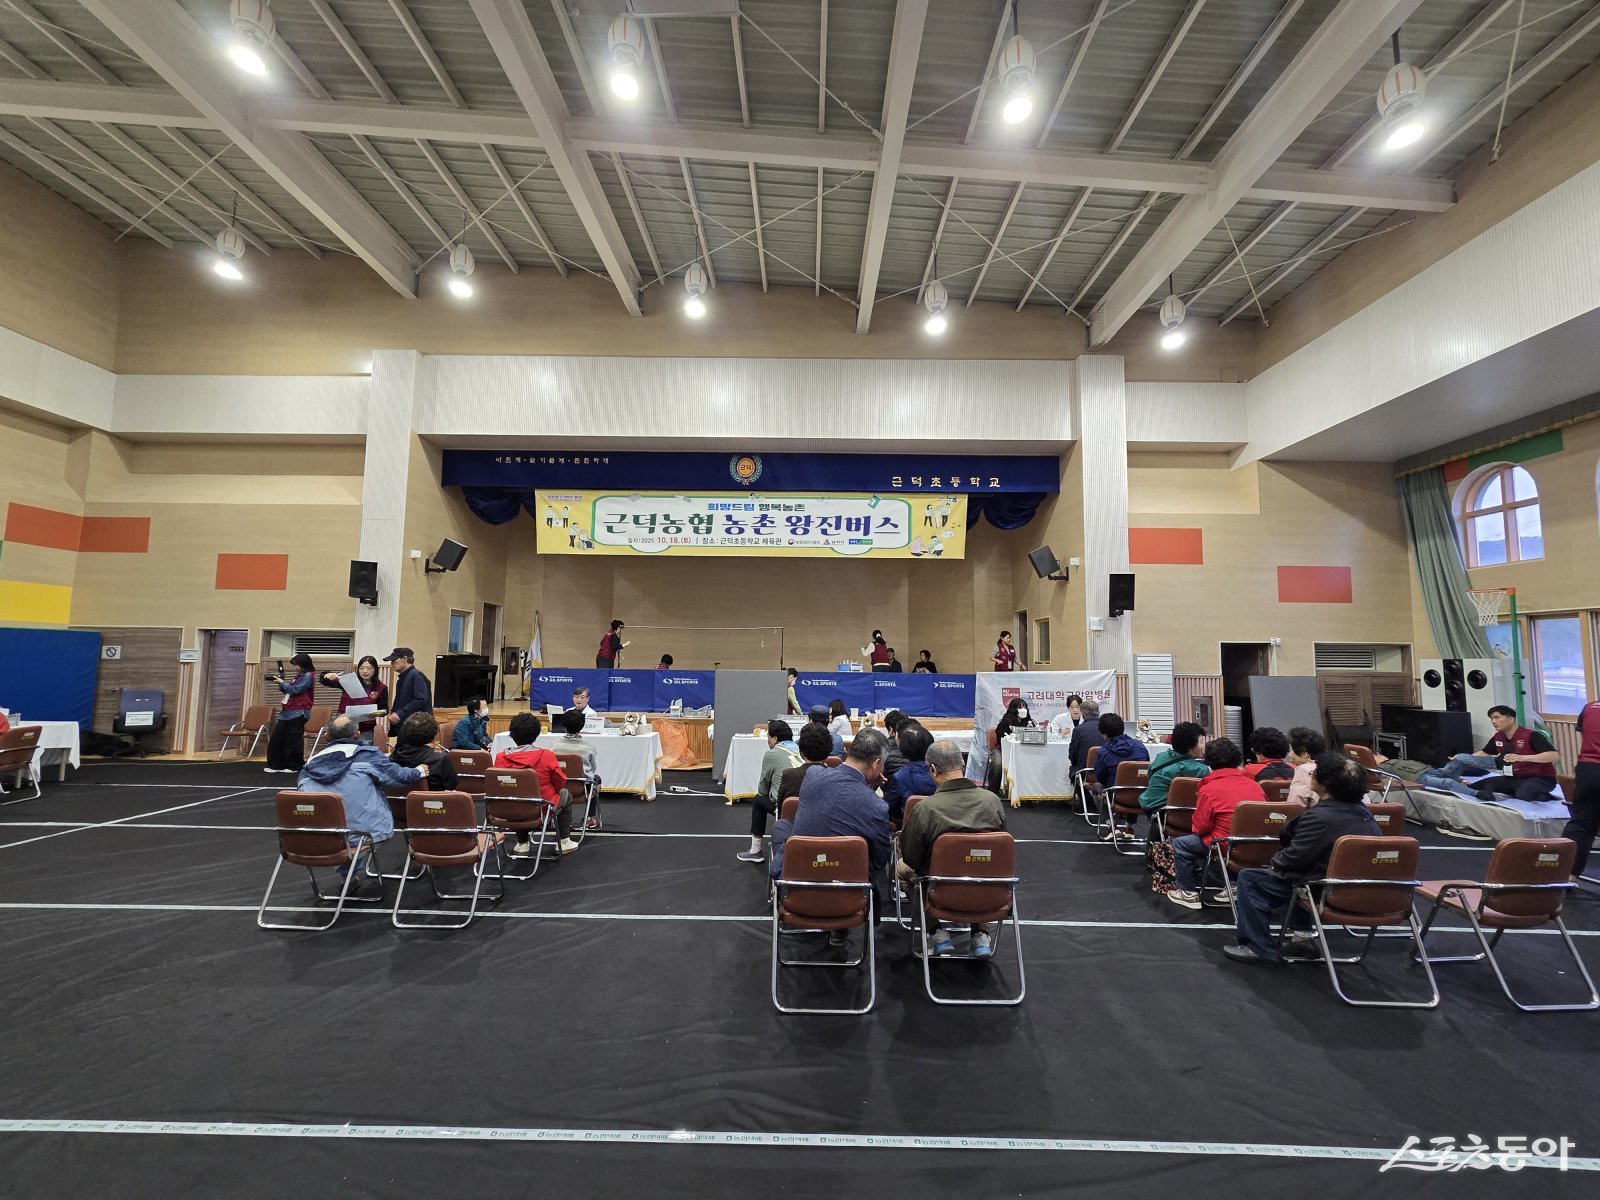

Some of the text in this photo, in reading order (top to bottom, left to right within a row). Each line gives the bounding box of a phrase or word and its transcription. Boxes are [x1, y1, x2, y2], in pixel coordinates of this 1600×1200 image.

[891, 476, 1001, 488] 근덕초등학교
[707, 502, 806, 512] 희망드림 행복농촌
[603, 512, 901, 537] 근덕농협 농촌 왕진버스
[720, 537, 760, 545] 근덕초등학교
[761, 537, 782, 546] 체육관
